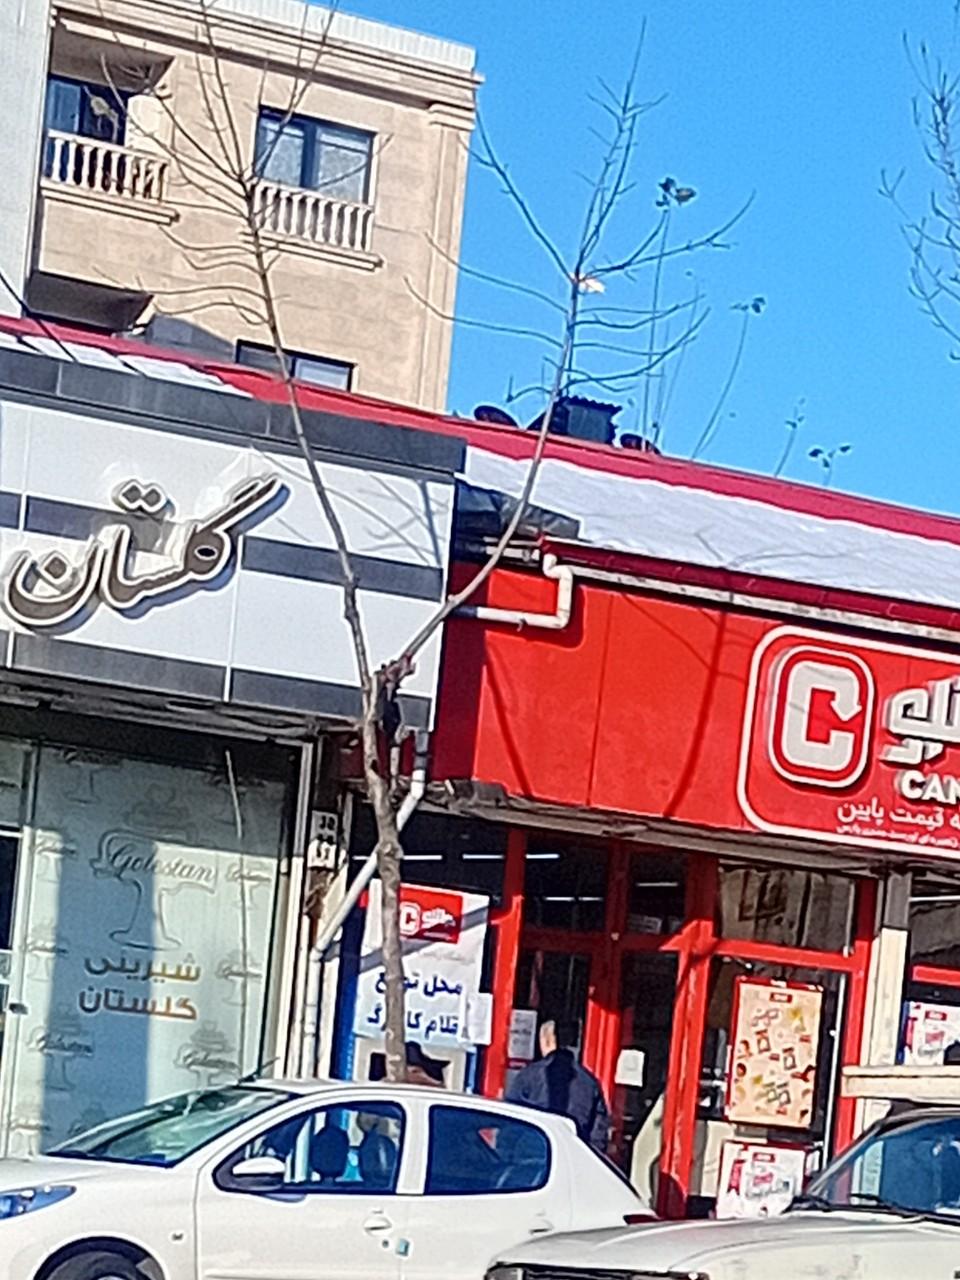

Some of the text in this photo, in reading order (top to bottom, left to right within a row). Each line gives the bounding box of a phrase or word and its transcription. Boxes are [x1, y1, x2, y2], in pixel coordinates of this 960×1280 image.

[5, 473, 288, 630] گلستان
[837, 797, 884, 825] پایین
[889, 806, 944, 830] قیمت
[84, 952, 201, 982] شیرینی
[423, 974, 463, 997] محل
[425, 1014, 461, 1040] قلام
